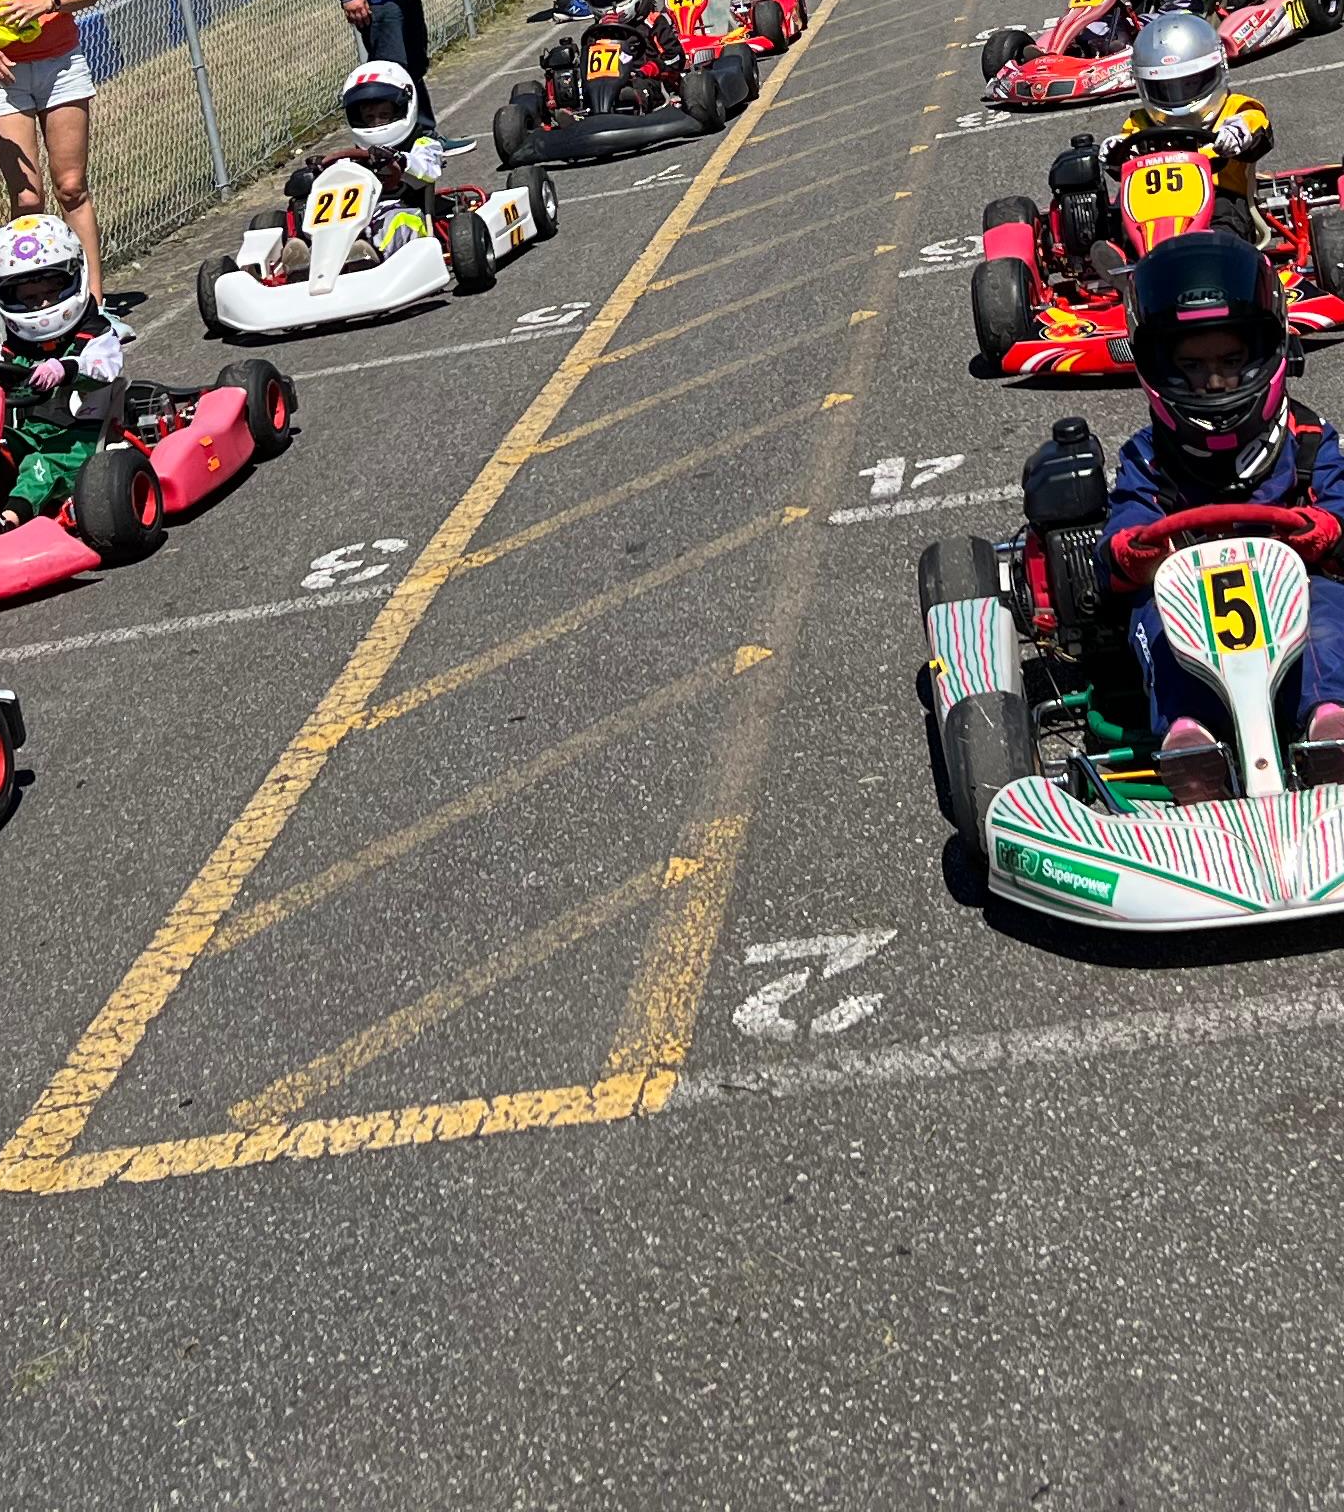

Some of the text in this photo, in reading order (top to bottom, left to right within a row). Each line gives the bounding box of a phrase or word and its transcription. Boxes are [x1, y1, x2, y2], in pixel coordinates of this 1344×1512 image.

[590, 48, 618, 73] 67
[1145, 167, 1184, 195] 95
[313, 187, 361, 226] 22
[1210, 568, 1257, 651] 5
[1041, 857, 1113, 891] Superpower
